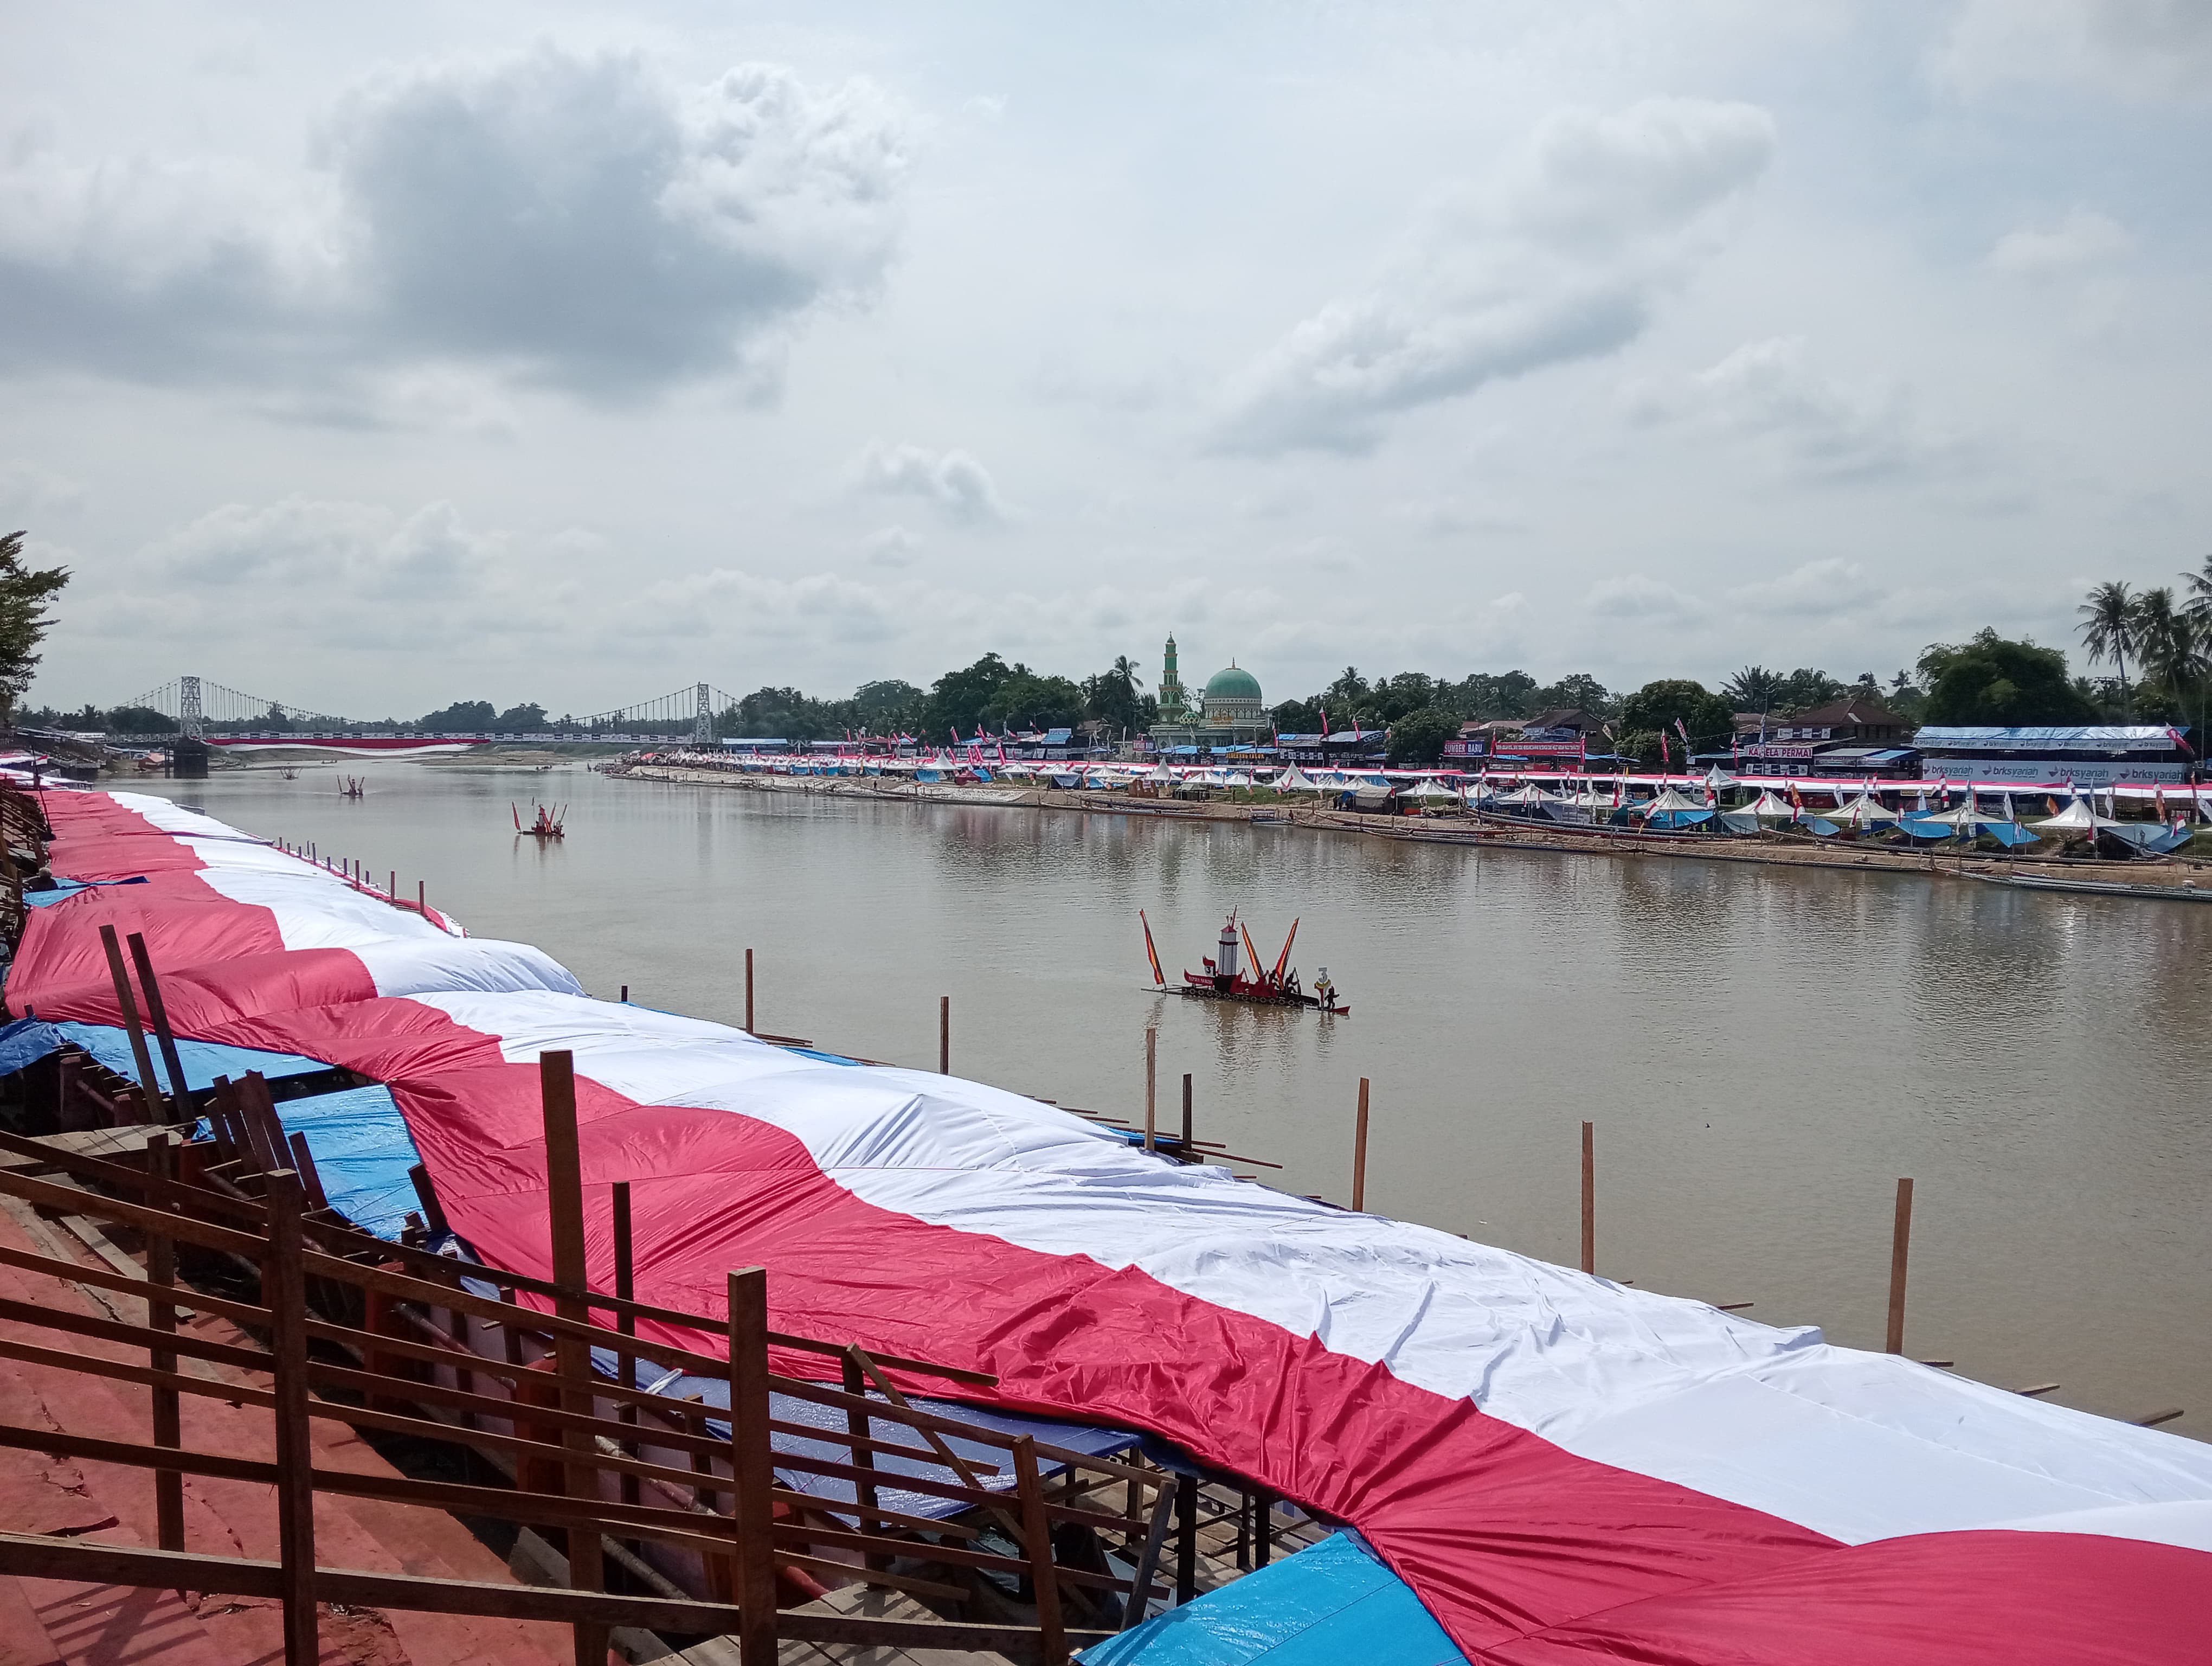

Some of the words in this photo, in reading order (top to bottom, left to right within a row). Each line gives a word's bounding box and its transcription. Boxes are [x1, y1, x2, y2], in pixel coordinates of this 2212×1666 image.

[1444, 744, 1465, 753] SUMBER
[1468, 744, 1482, 753] BARU
[1782, 748, 1811, 757] PERMAI
[1932, 765, 1973, 776] brksyariah
[1993, 766, 2039, 777] brksyariah
[2061, 768, 2108, 778] brksyariah
[2132, 768, 2183, 780] brksyariah
[1318, 967, 1328, 983] 3
